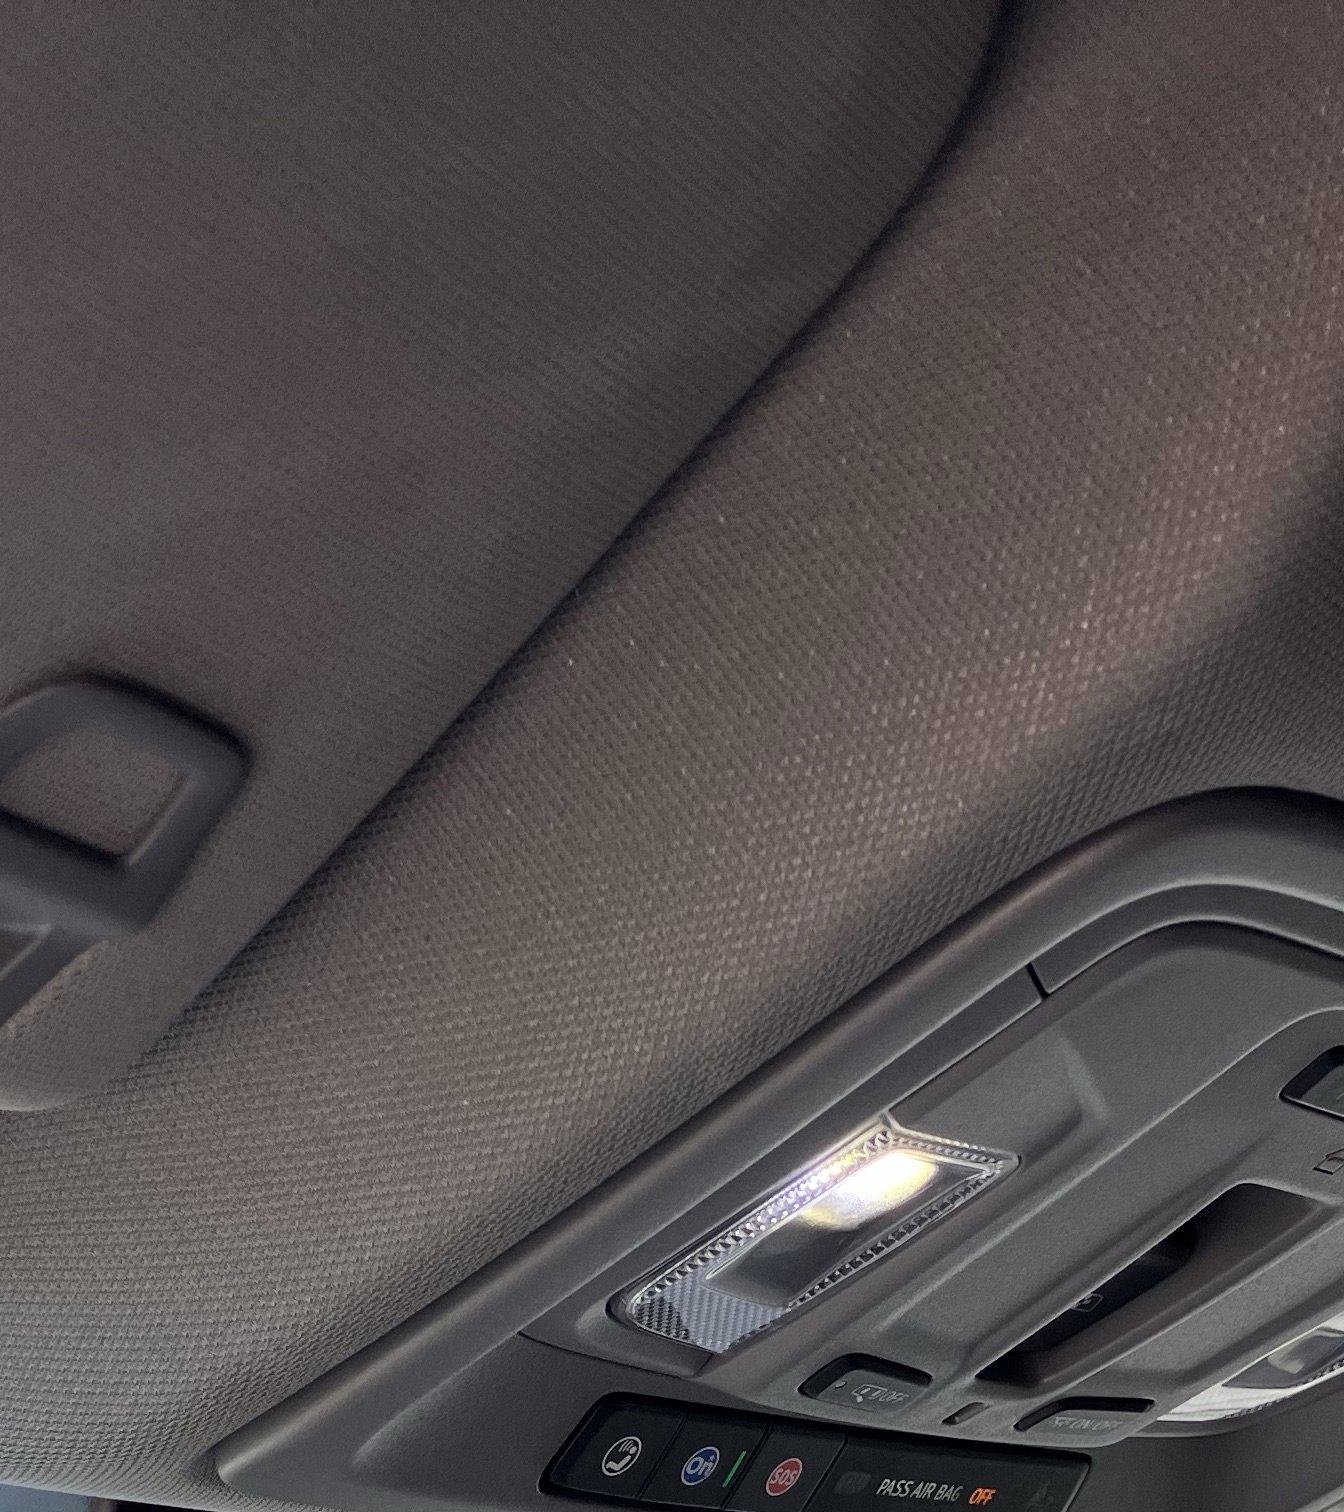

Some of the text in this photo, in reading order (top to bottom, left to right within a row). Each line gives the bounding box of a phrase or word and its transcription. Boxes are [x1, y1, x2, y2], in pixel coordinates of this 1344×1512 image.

[770, 1468, 798, 1486] SOS
[876, 1478, 997, 1505] PASS AIR BAG OFF
